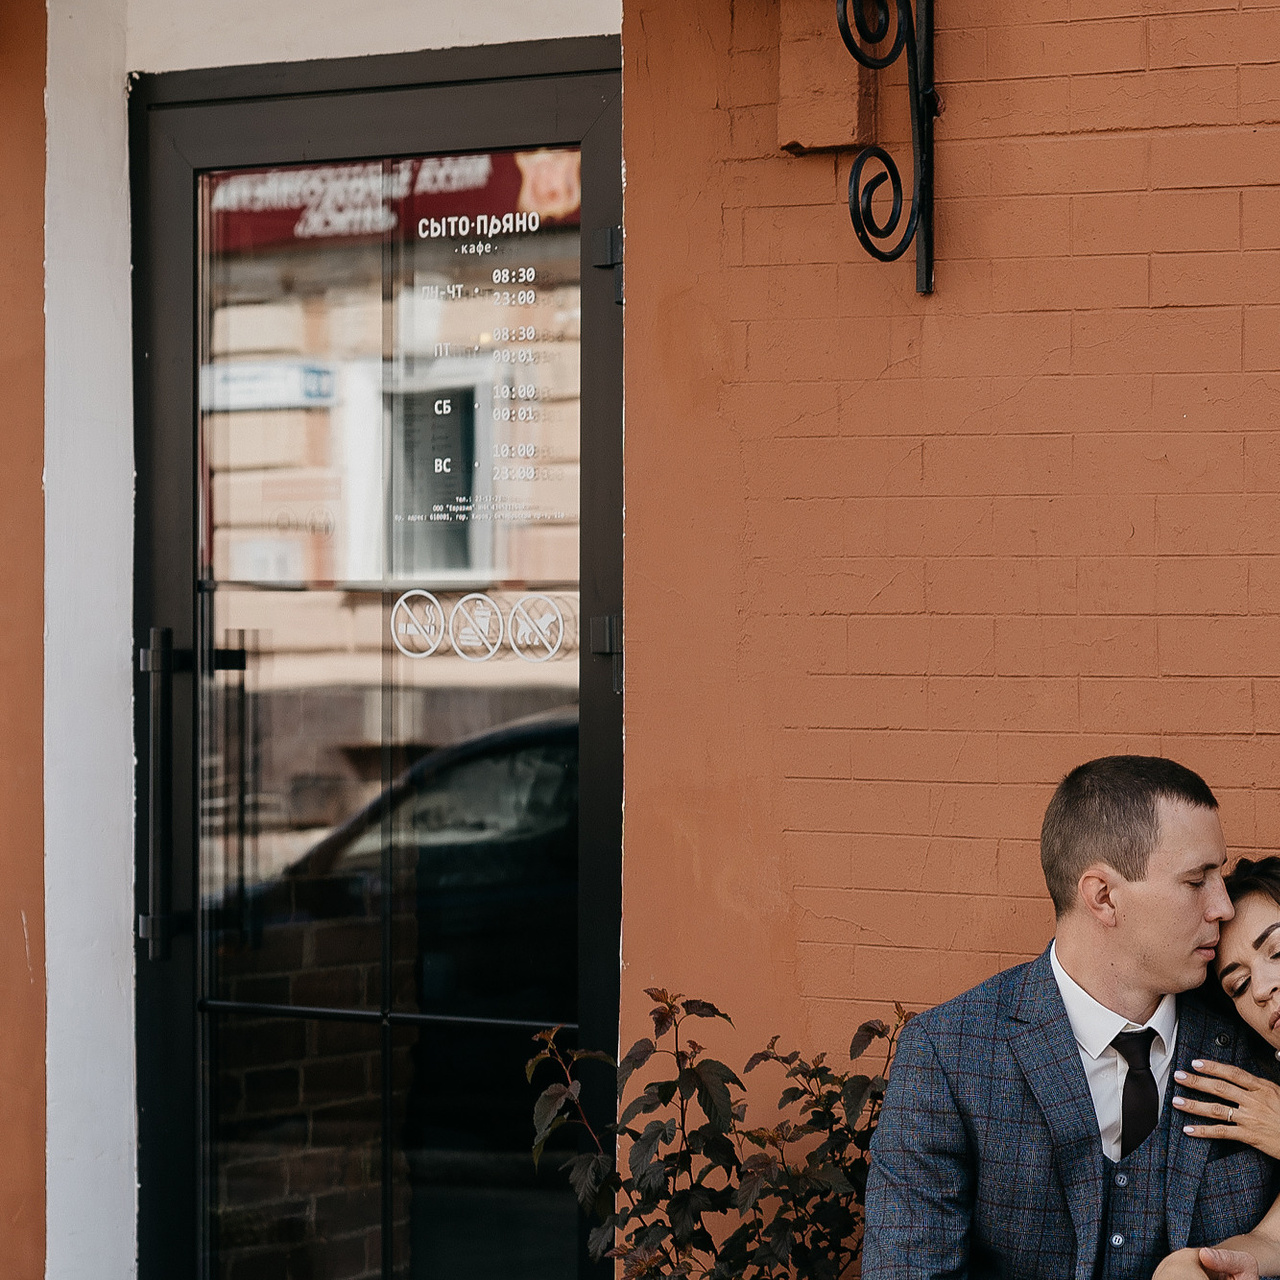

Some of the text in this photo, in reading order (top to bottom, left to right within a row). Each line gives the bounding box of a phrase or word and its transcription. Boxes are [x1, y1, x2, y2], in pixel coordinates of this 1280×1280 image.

[492, 267, 536, 284] 08:30
[421, 284, 464, 300] ПН-ЧТ
[492, 290, 536, 306] 23:00
[492, 326, 536, 341] 08:30
[434, 342, 451, 357] ПТ
[493, 384, 536, 399] 10:00
[434, 399, 452, 415] СБ
[492, 407, 535, 422] 00:01
[493, 443, 536, 458] 10:00
[434, 458, 452, 473] ВС
[492, 466, 536, 481] 23:00
